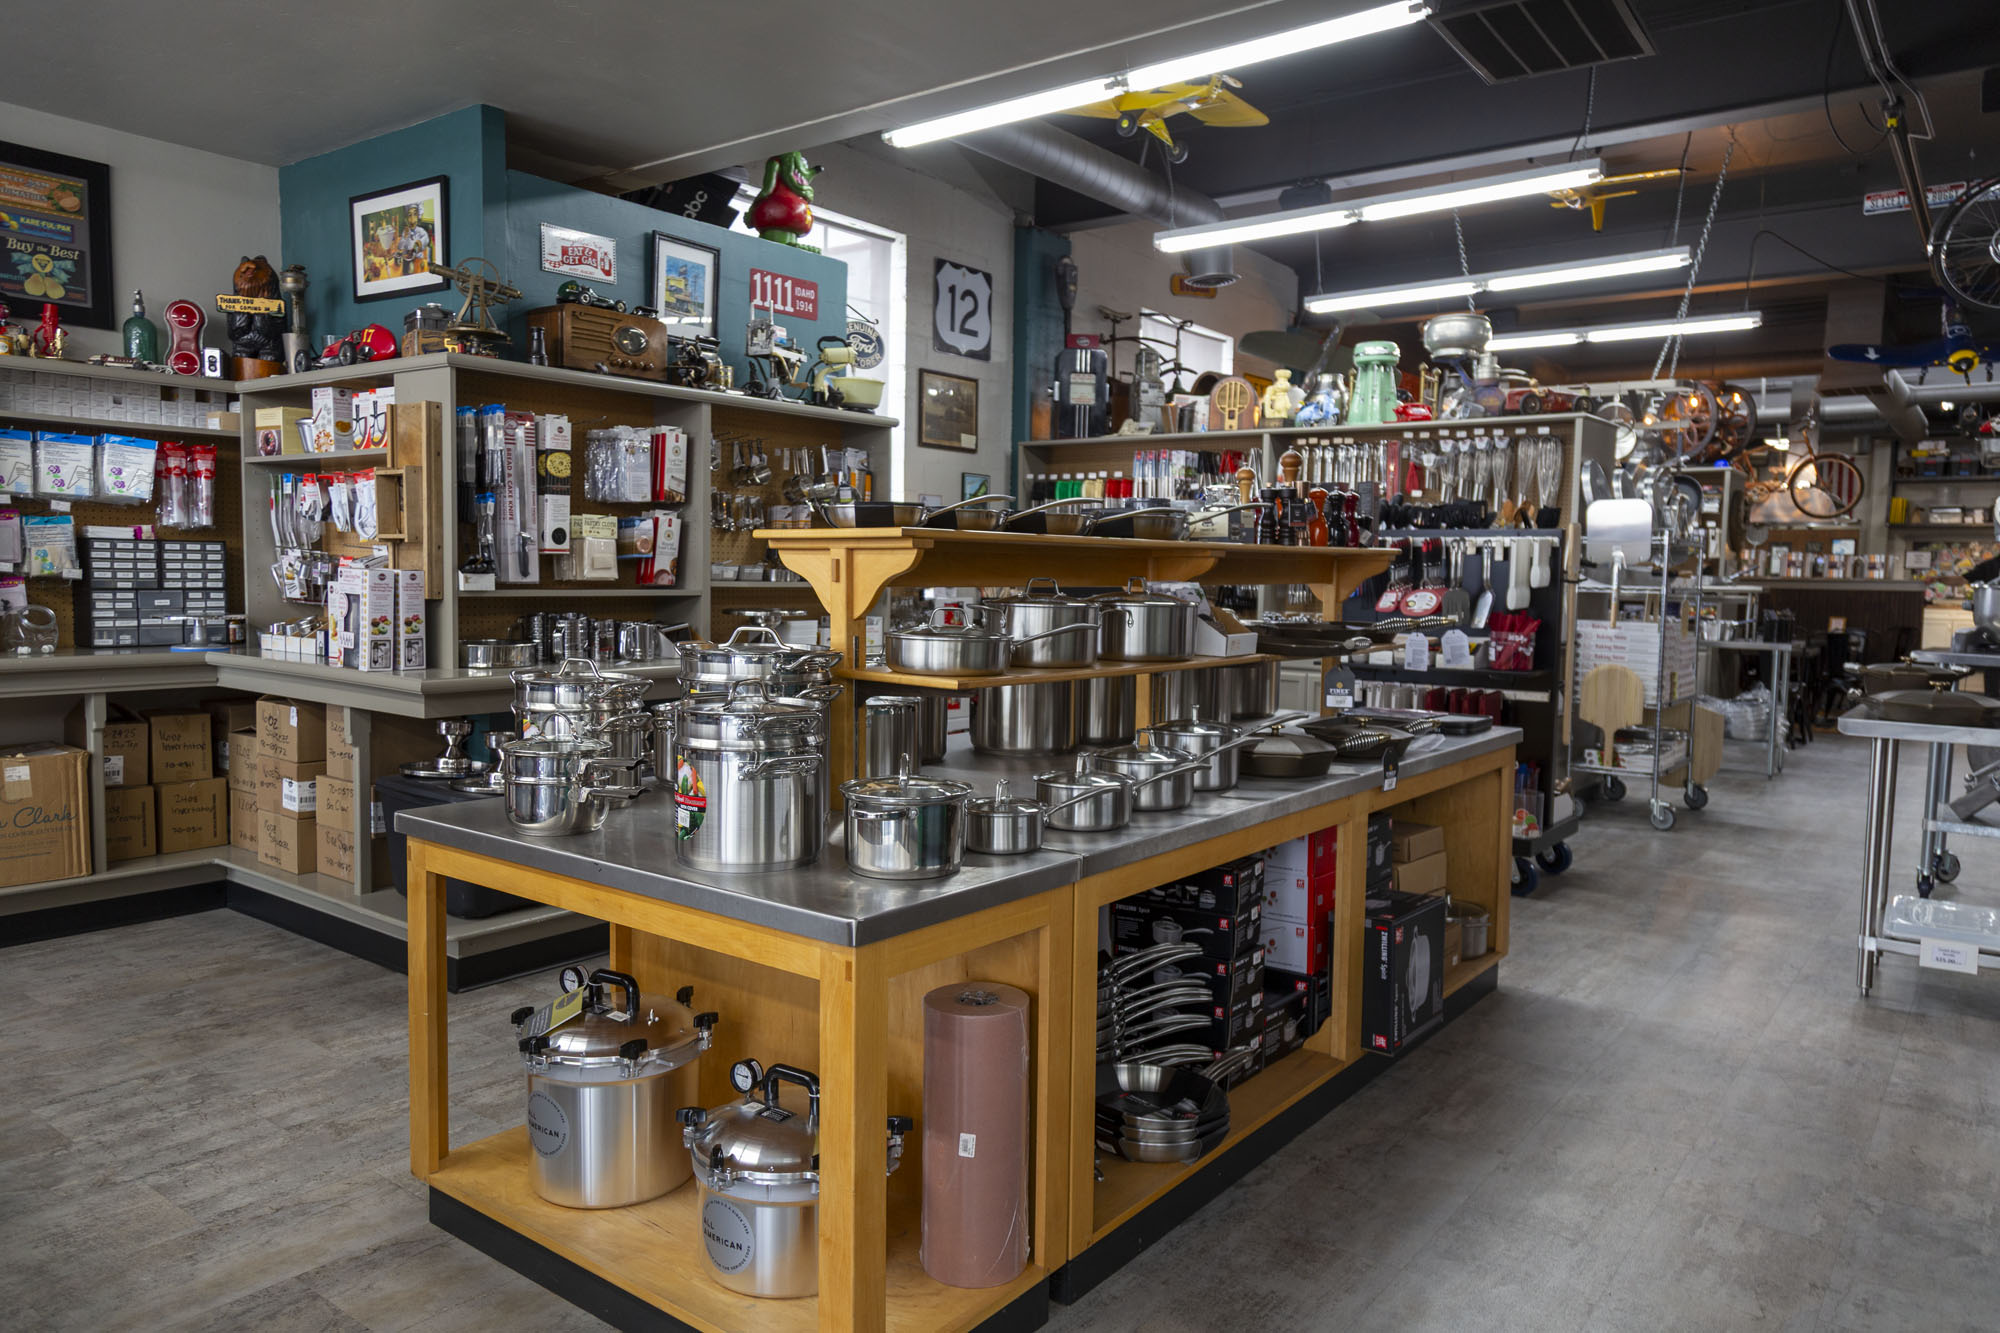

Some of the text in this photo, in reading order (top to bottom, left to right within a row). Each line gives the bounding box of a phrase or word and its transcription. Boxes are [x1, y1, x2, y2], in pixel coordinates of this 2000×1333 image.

[682, 190, 708, 218] abc
[6, 237, 35, 254] Buy
[49, 243, 80, 260] Best
[568, 247, 593, 257] EAT &
[563, 256, 597, 267] GET GAS
[752, 272, 794, 312] 1111
[794, 286, 816, 300] IDAHO
[795, 299, 813, 313] 1914
[948, 284, 979, 338] 12
[362, 328, 376, 343] 17
[846, 333, 876, 354] Ford
[505, 447, 513, 471] BREAD
[507, 500, 515, 520] KNIFE
[13, 804, 78, 828] Clark
[703, 1215, 715, 1231] ALL
[703, 1227, 743, 1252] AMERICAN
